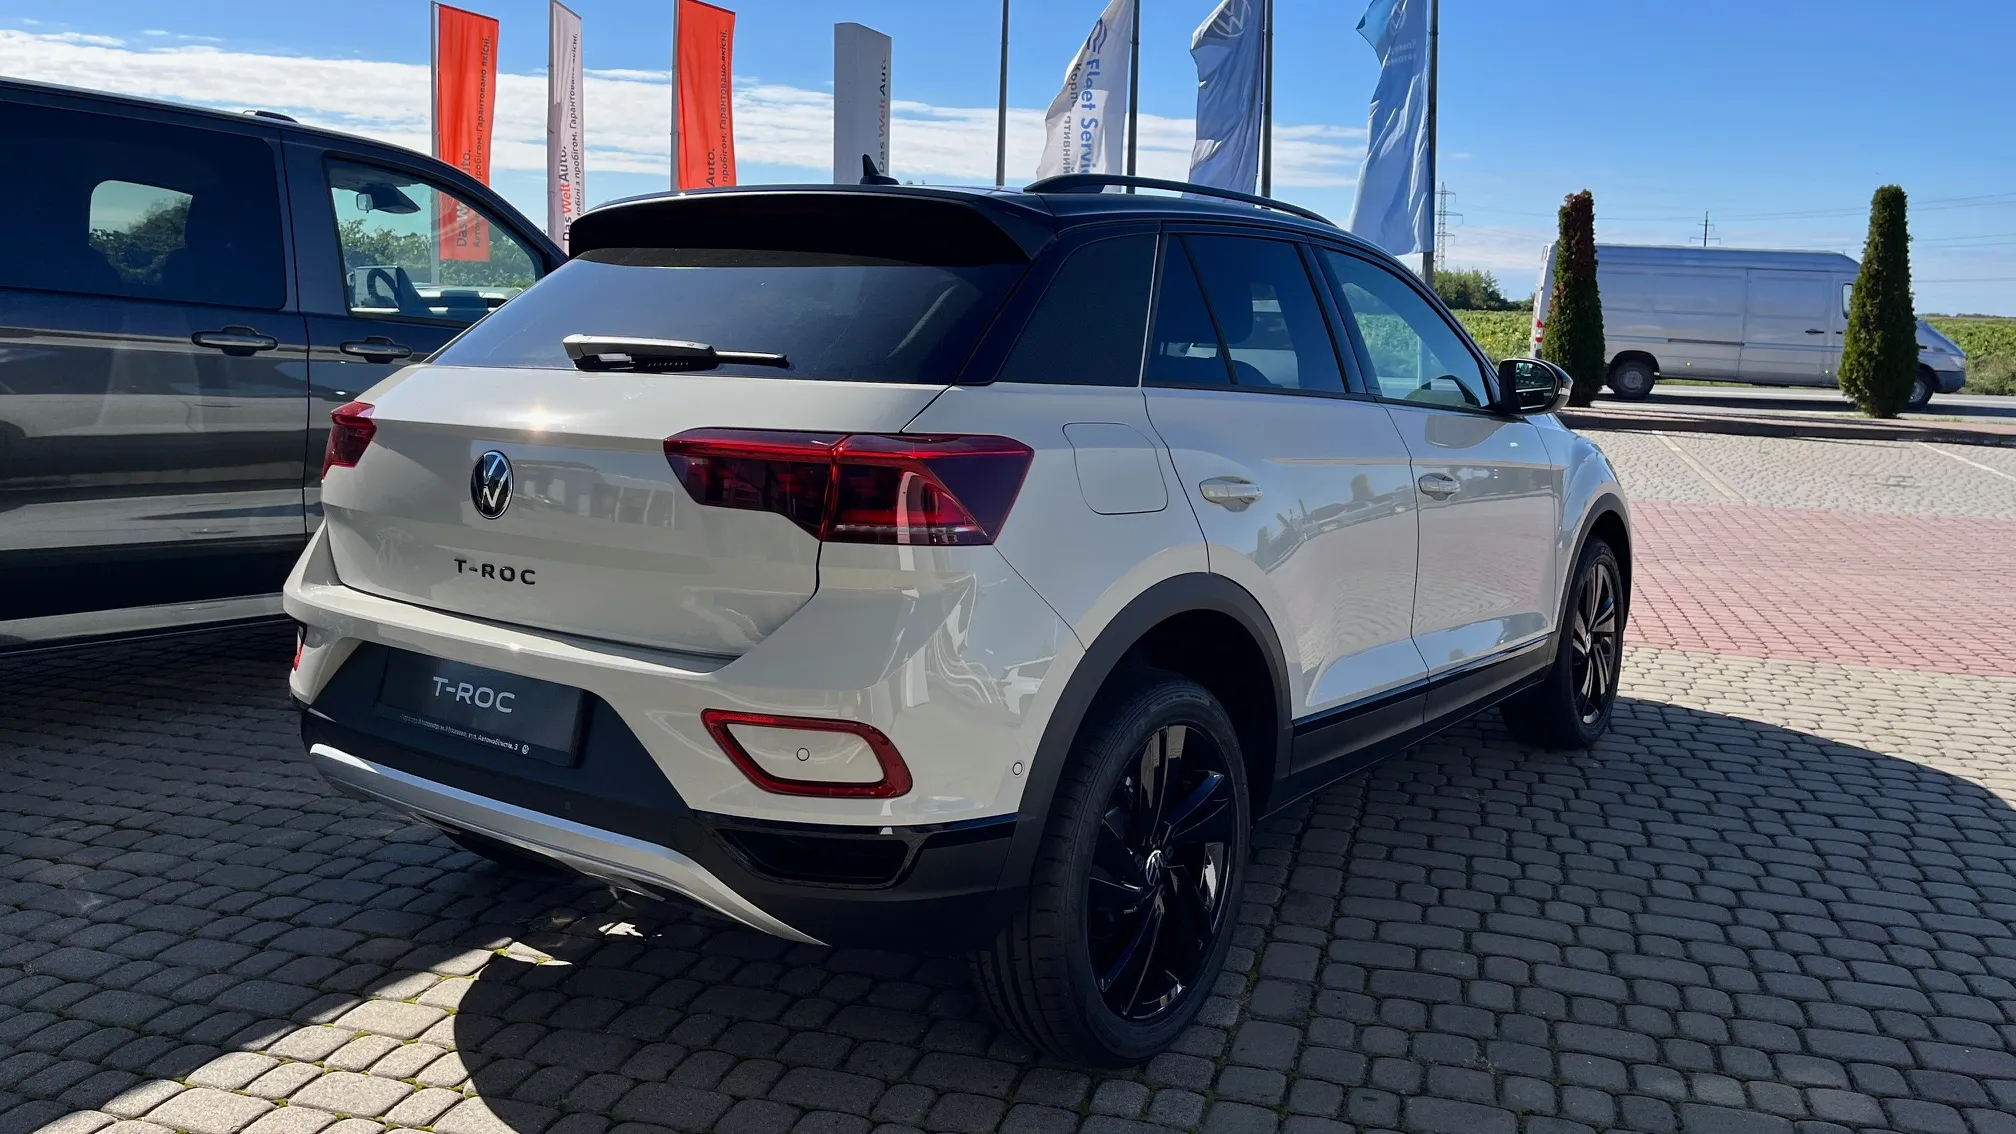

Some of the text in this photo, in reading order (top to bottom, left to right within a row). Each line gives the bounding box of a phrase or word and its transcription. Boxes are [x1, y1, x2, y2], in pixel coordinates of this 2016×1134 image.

[481, 36, 491, 67] якісні.
[476, 69, 487, 132] Гарантовано
[571, 131, 582, 178] пробігом.
[720, 133, 728, 182] пробігом.
[1080, 117, 1098, 174] Servi
[706, 148, 716, 187] Auto.
[456, 223, 468, 248] Das
[563, 216, 573, 242] Das
[453, 558, 536, 586] T-ROC
[432, 676, 516, 713] T-ROC
